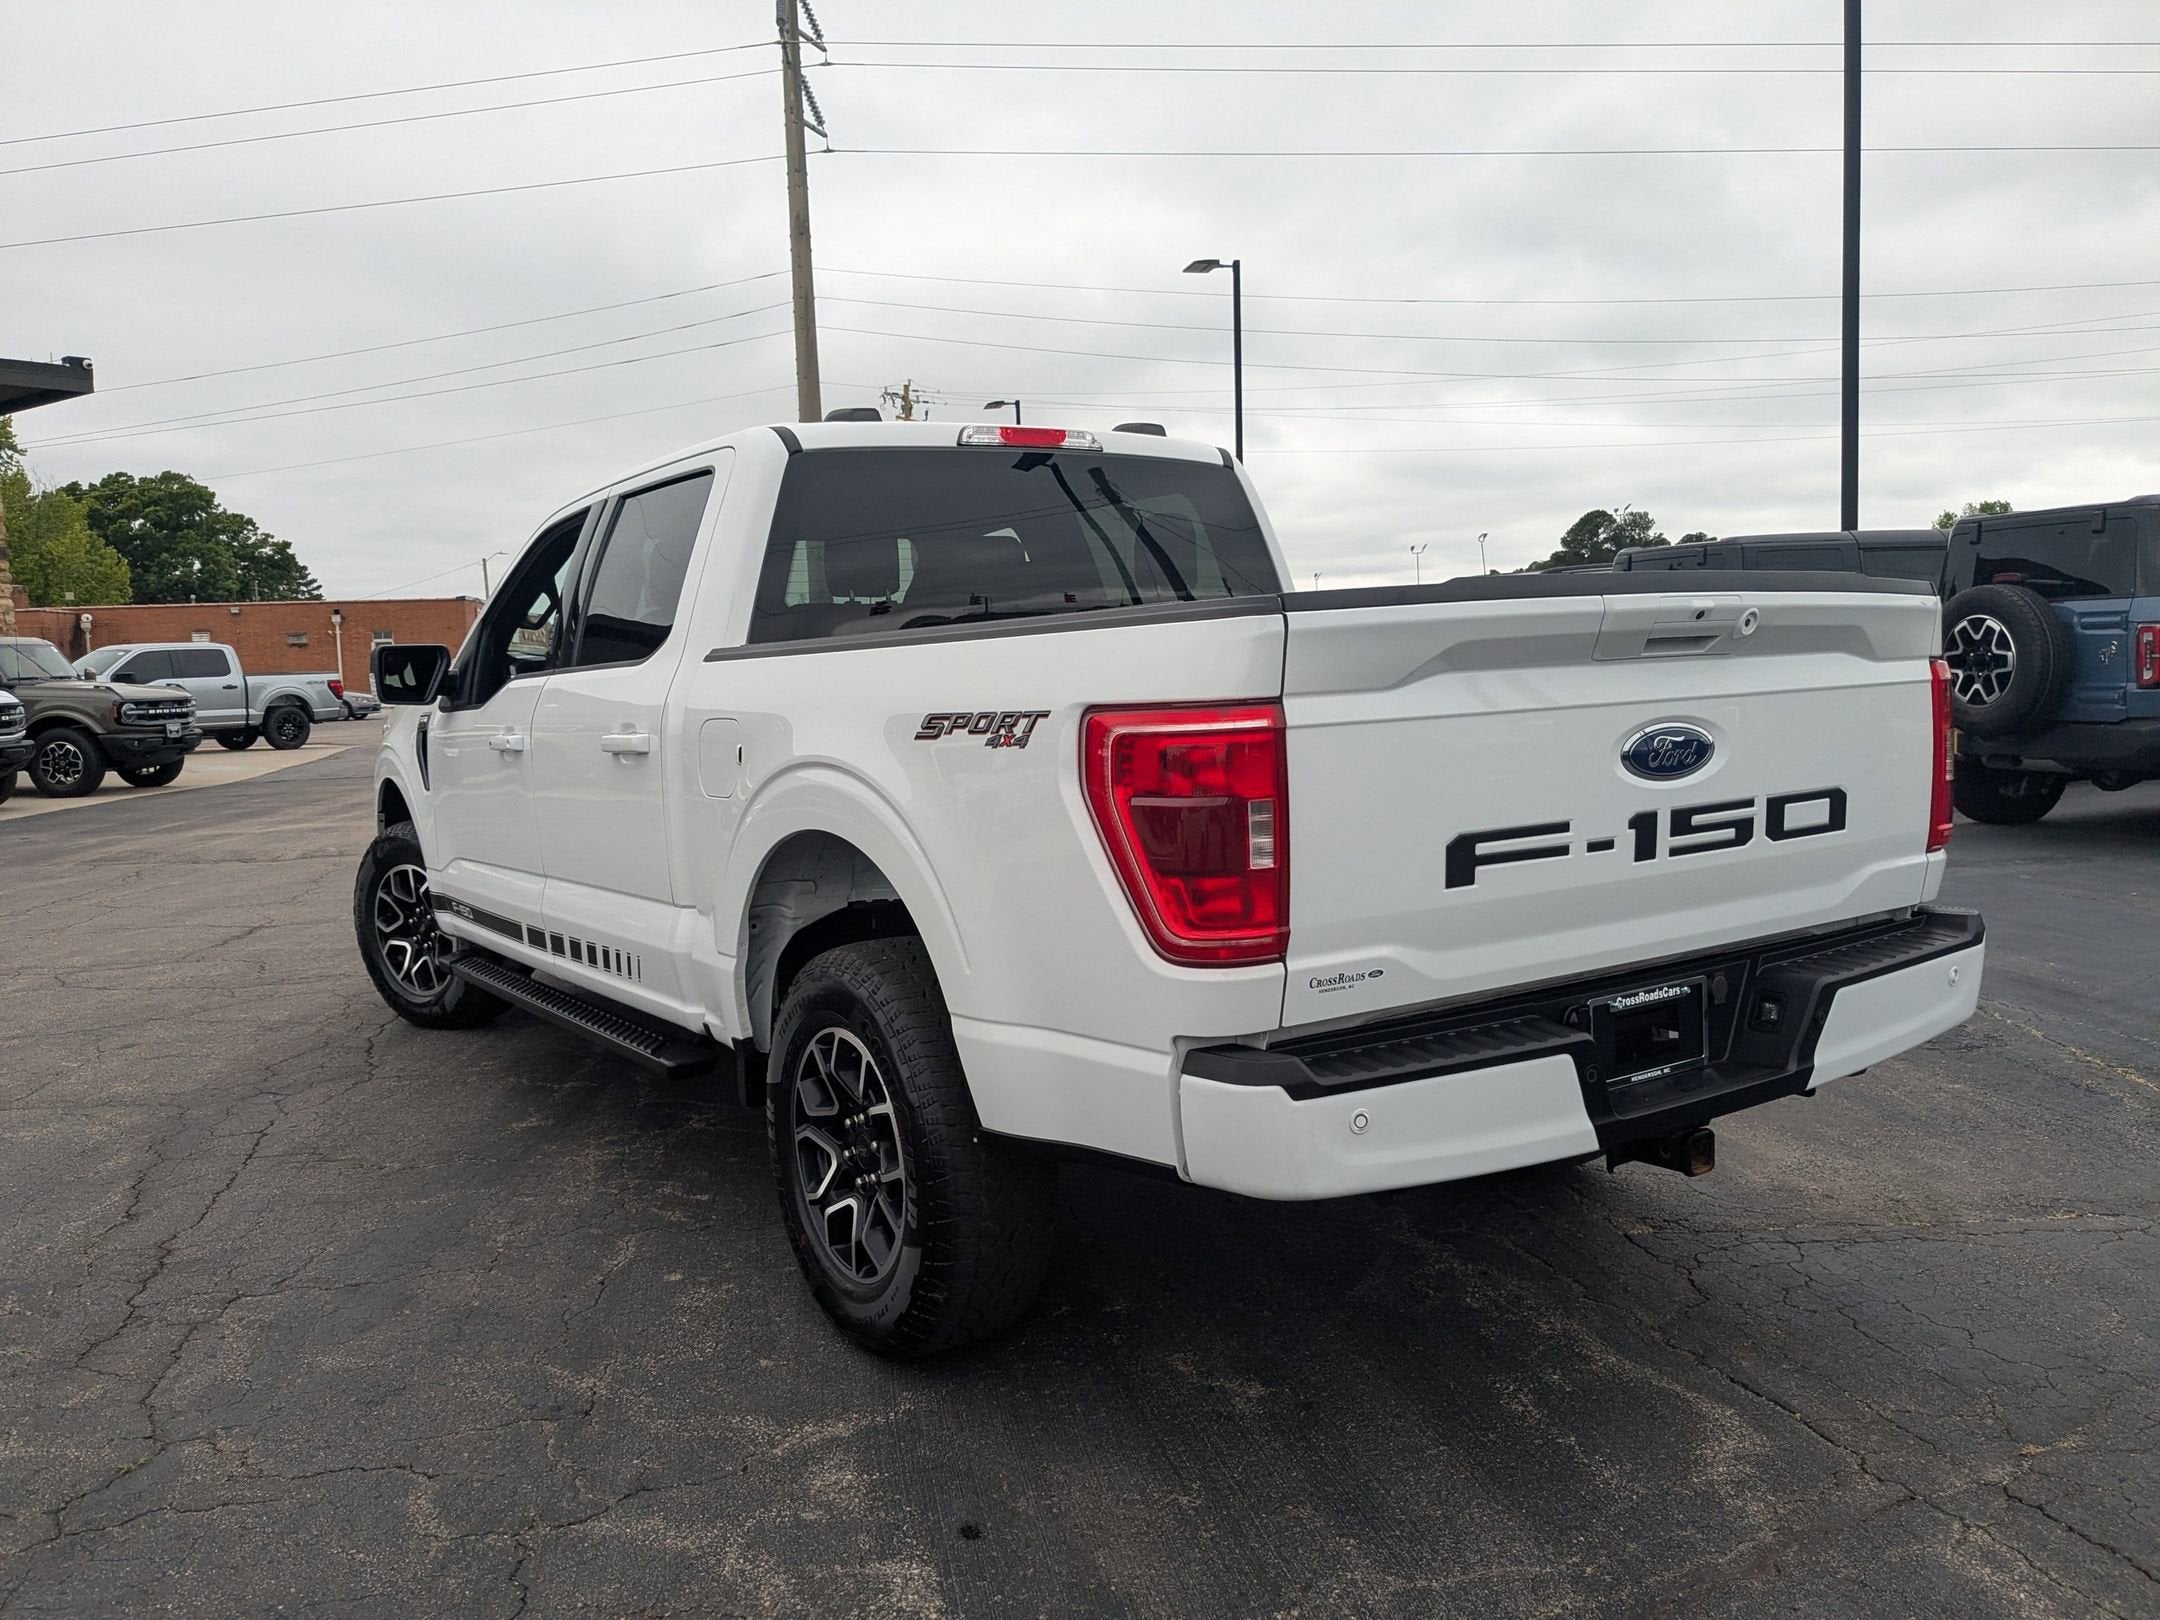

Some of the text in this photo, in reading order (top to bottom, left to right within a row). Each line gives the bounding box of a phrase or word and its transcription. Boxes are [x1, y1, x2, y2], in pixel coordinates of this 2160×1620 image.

[914, 710, 1051, 740] SPORT
[1649, 735, 1698, 768] Ford
[1445, 786, 1847, 889] F-150
[1616, 986, 1680, 1008] CrossRoadsCars
